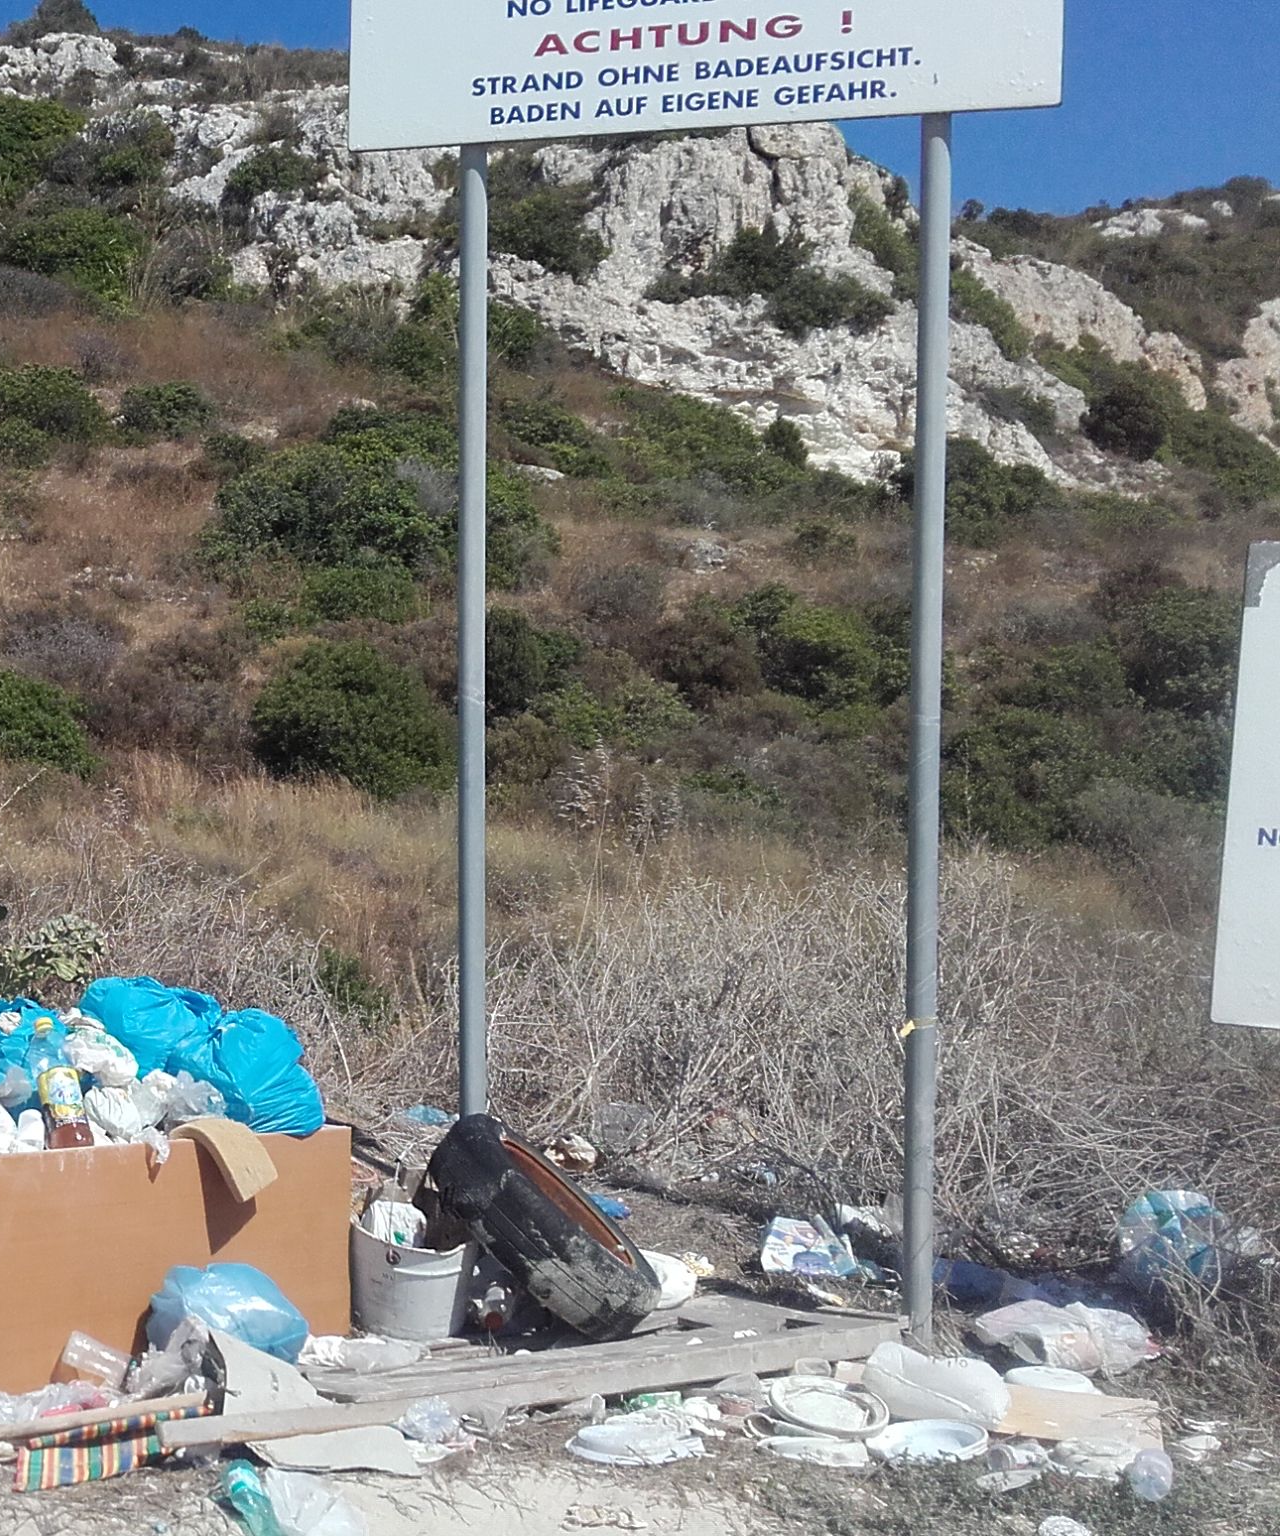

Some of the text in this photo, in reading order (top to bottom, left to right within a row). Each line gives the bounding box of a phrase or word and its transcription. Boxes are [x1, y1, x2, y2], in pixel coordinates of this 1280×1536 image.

[506, 0, 551, 18] NO
[533, 10, 852, 57] ACHTUNG !
[471, 46, 922, 96] STRAND OHNE BADEAUFSICHT.
[489, 79, 898, 125] BADEN AUF EIGENE GEFAHR.
